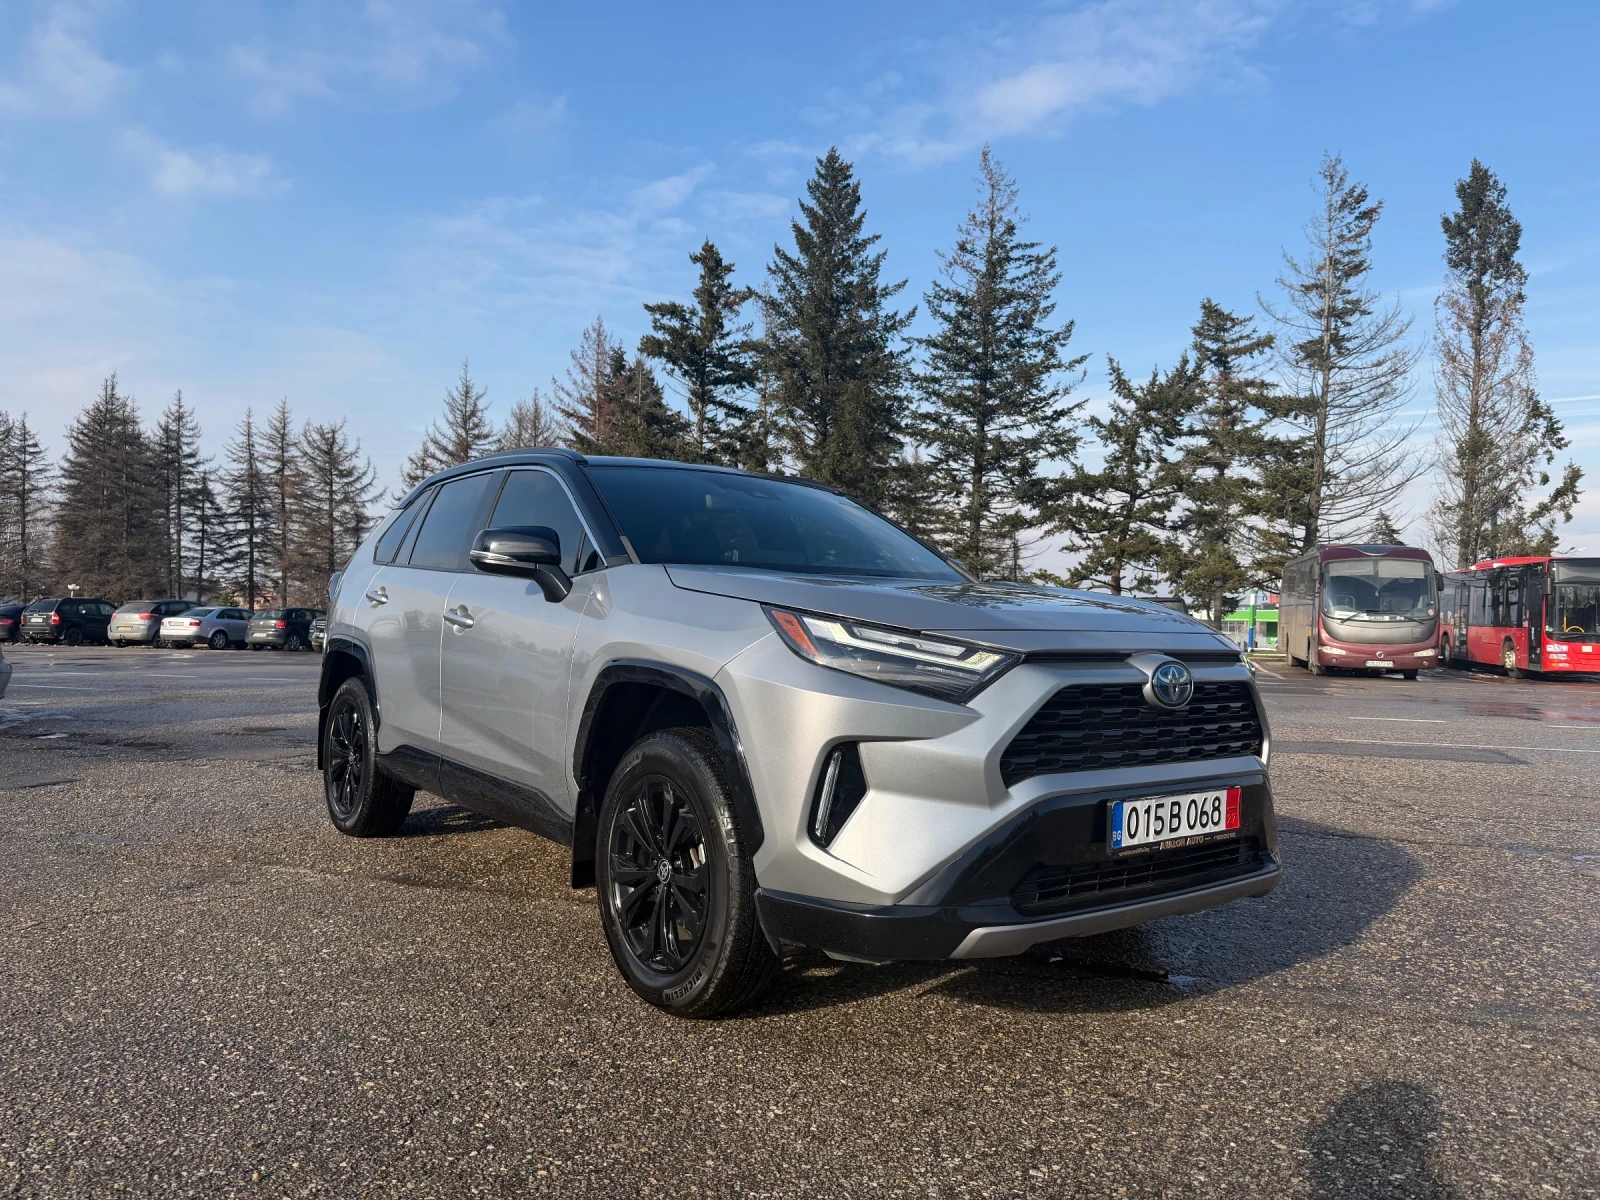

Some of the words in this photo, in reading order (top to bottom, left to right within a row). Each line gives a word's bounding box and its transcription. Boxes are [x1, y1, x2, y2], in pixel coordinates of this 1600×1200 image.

[1112, 830, 1122, 841] BG
[1160, 838, 1186, 851] AVALON
[1186, 835, 1204, 846] AUTO
[664, 967, 703, 1002] MICHELIN
